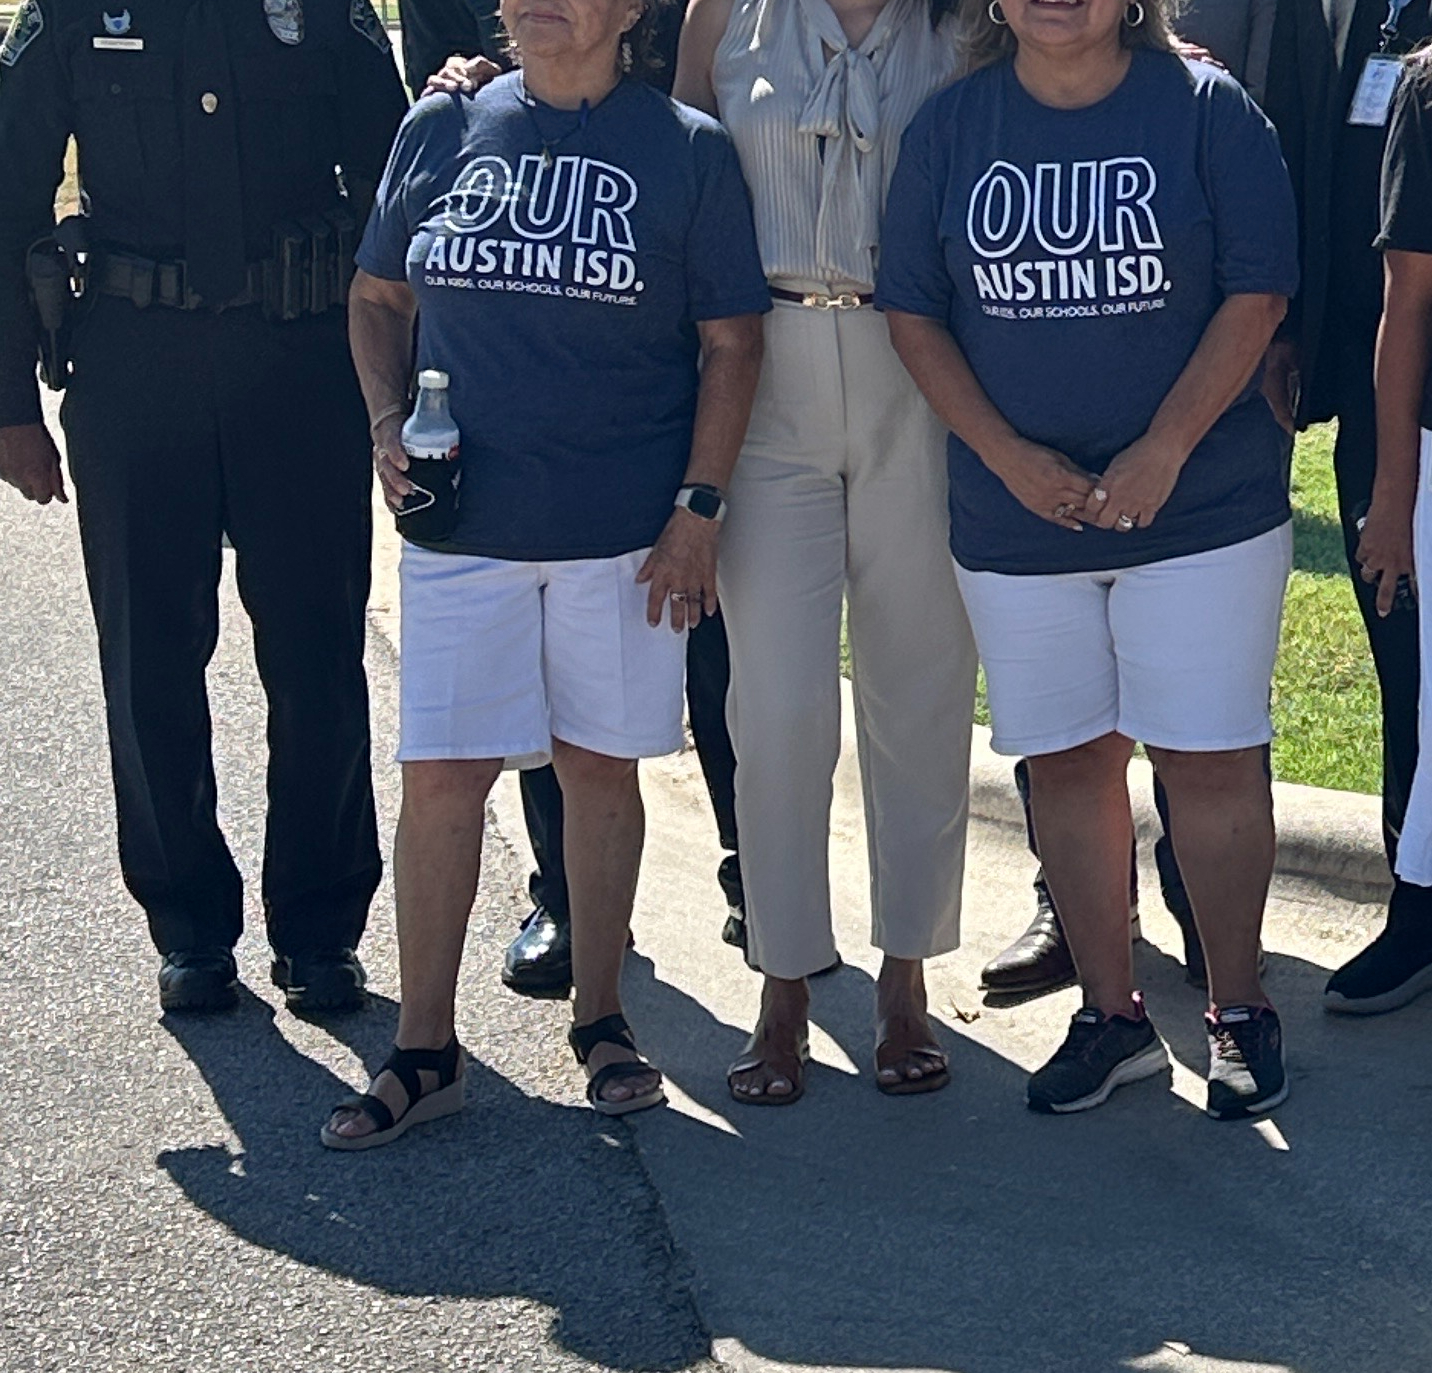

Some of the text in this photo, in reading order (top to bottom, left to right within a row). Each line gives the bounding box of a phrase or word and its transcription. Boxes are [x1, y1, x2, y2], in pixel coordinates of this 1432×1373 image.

[445, 155, 637, 252] OUR
[967, 156, 1164, 258] OUR
[425, 235, 645, 292] AUSTIN ISD.
[478, 278, 504, 290] OUR
[565, 286, 591, 299] OUR
[972, 255, 1172, 301] AUSTIN ISD.
[1019, 307, 1044, 319] OUR
[1101, 302, 1127, 315] OUR
